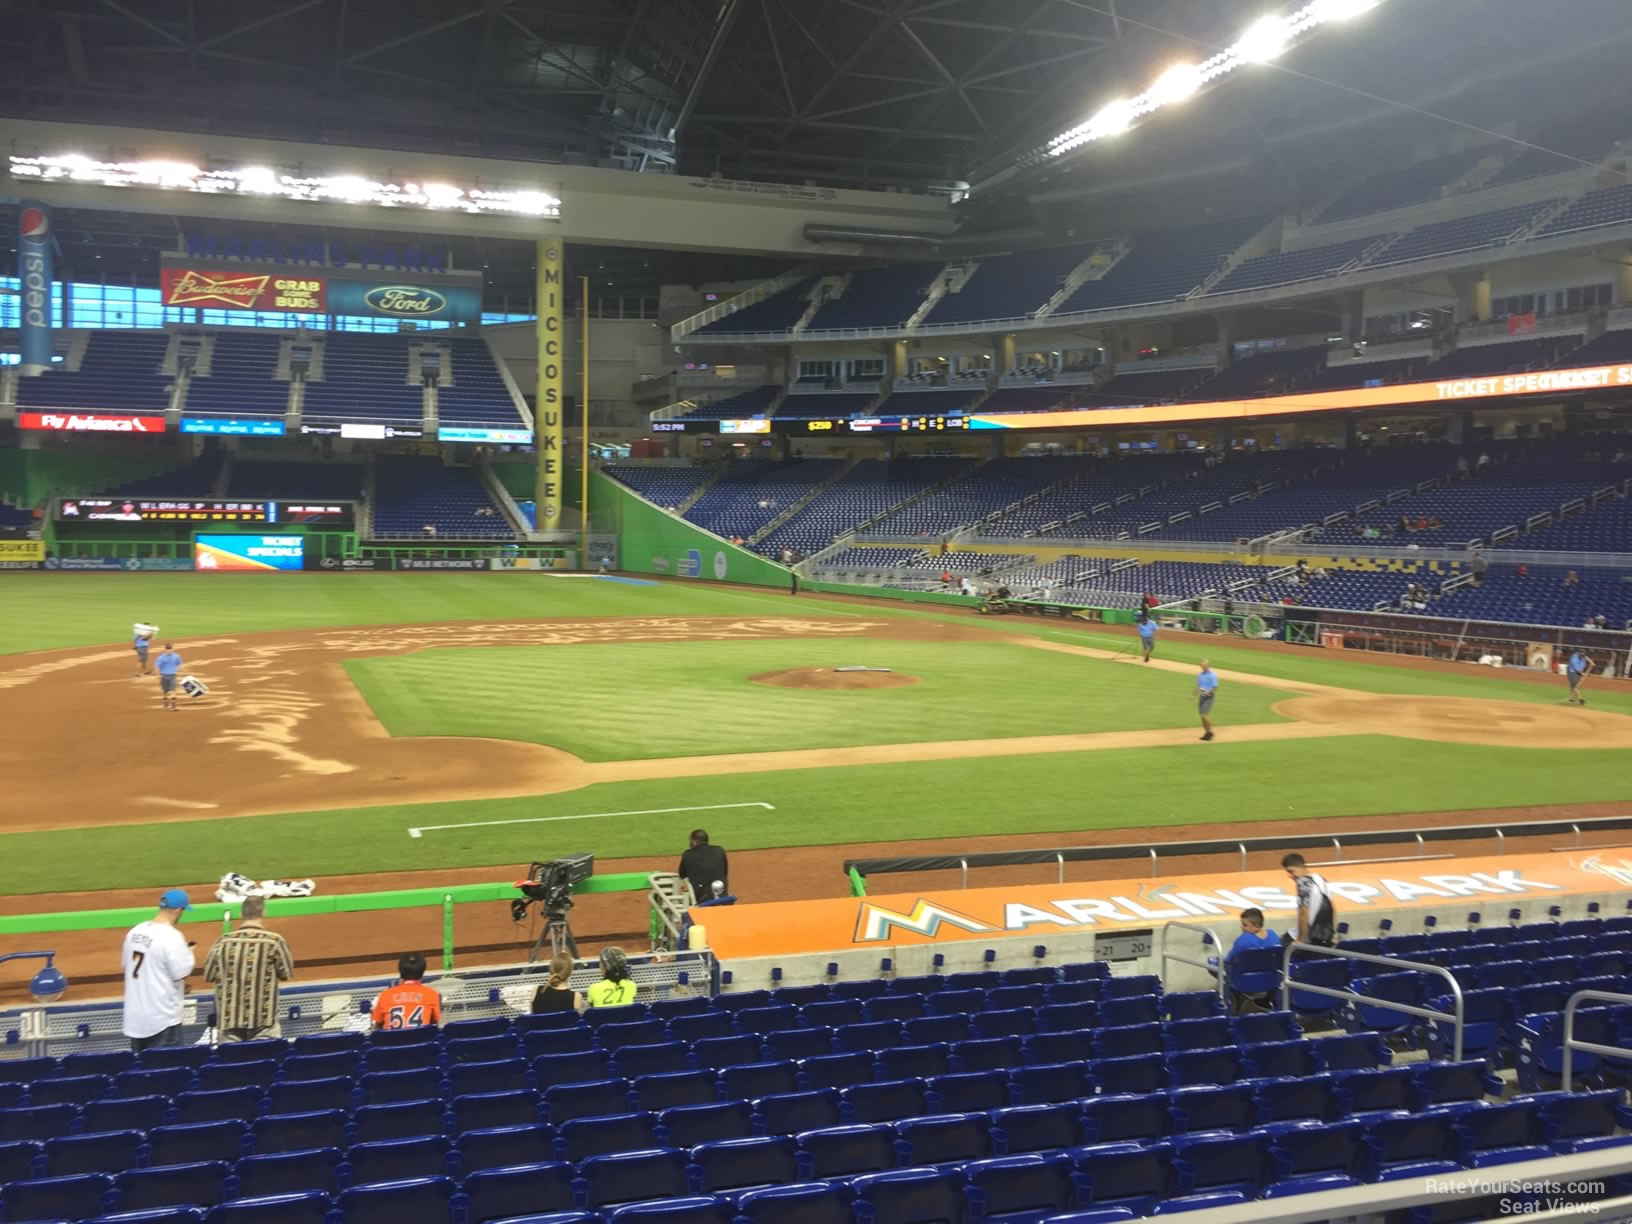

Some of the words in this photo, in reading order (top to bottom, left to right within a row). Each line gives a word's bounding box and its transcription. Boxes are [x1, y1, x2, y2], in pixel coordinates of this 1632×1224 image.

[22, 251, 47, 327] pepsi
[173, 278, 265, 296] Budweiser
[274, 279, 320, 292] GRAB
[274, 297, 319, 308] BUDS
[380, 289, 431, 311] Ford
[544, 268, 559, 497] MICCOSUKEE
[1436, 379, 1498, 399] TICKET
[42, 415, 65, 429] Fly
[66, 416, 132, 431] Avianca
[652, 423, 671, 431] 5:52
[672, 423, 685, 431] PM
[808, 421, 832, 431] $250
[413, 559, 431, 568] MLB
[432, 559, 473, 568] NETWORK
[853, 885, 1299, 943] MARLINS
[1327, 869, 1565, 904] PARK
[1102, 945, 1113, 956] 21
[1131, 942, 1146, 953] 20
[132, 950, 145, 979] 7
[388, 1005, 424, 1030] 54
